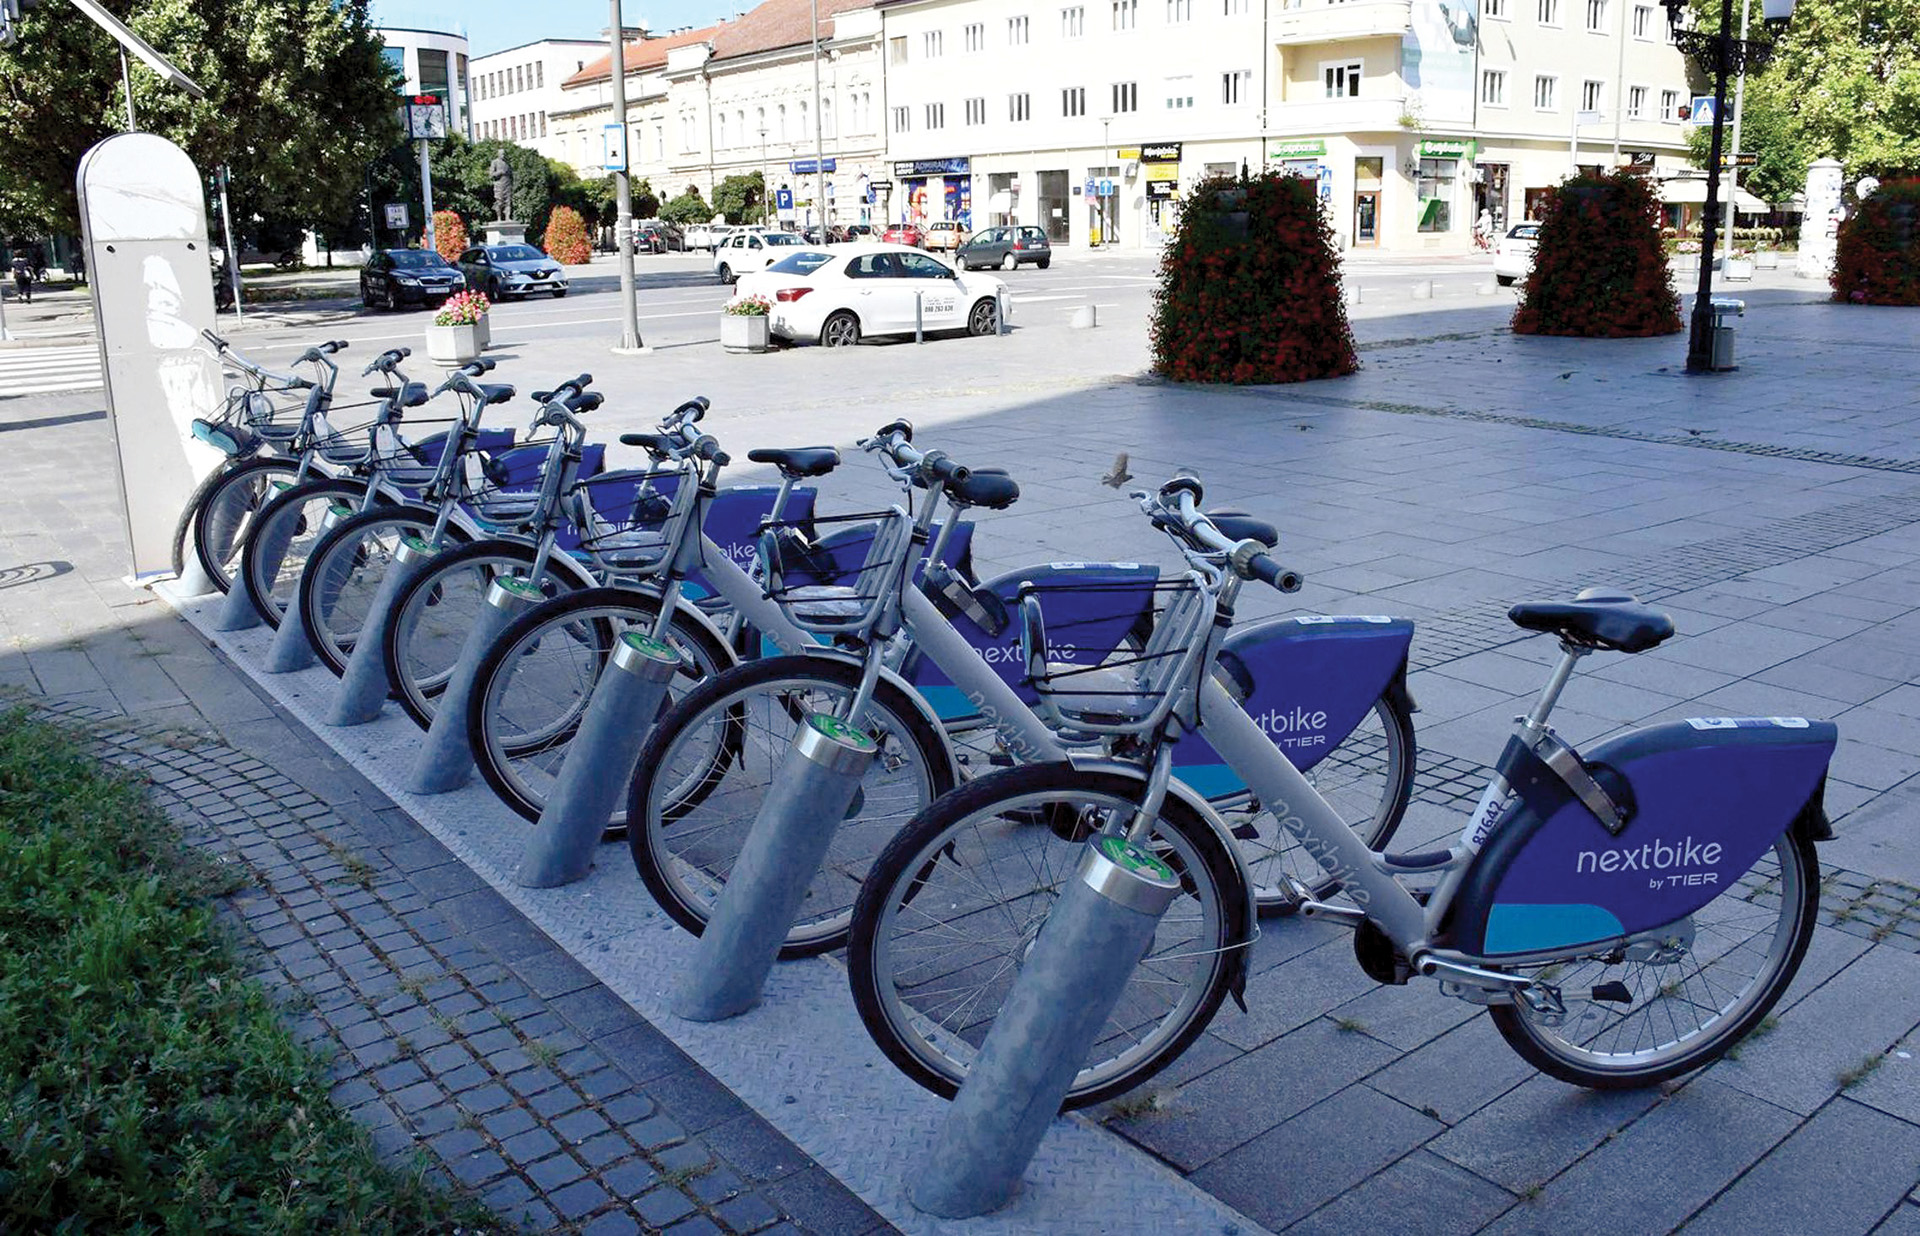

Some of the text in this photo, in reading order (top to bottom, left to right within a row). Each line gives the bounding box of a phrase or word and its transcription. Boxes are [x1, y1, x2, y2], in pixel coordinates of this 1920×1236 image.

[780, 193, 788, 206] P
[1284, 735, 1325, 748] TIER
[1472, 800, 1508, 845] 87642
[1576, 836, 1723, 873] nextbike
[1650, 872, 1719, 890] by TIER
